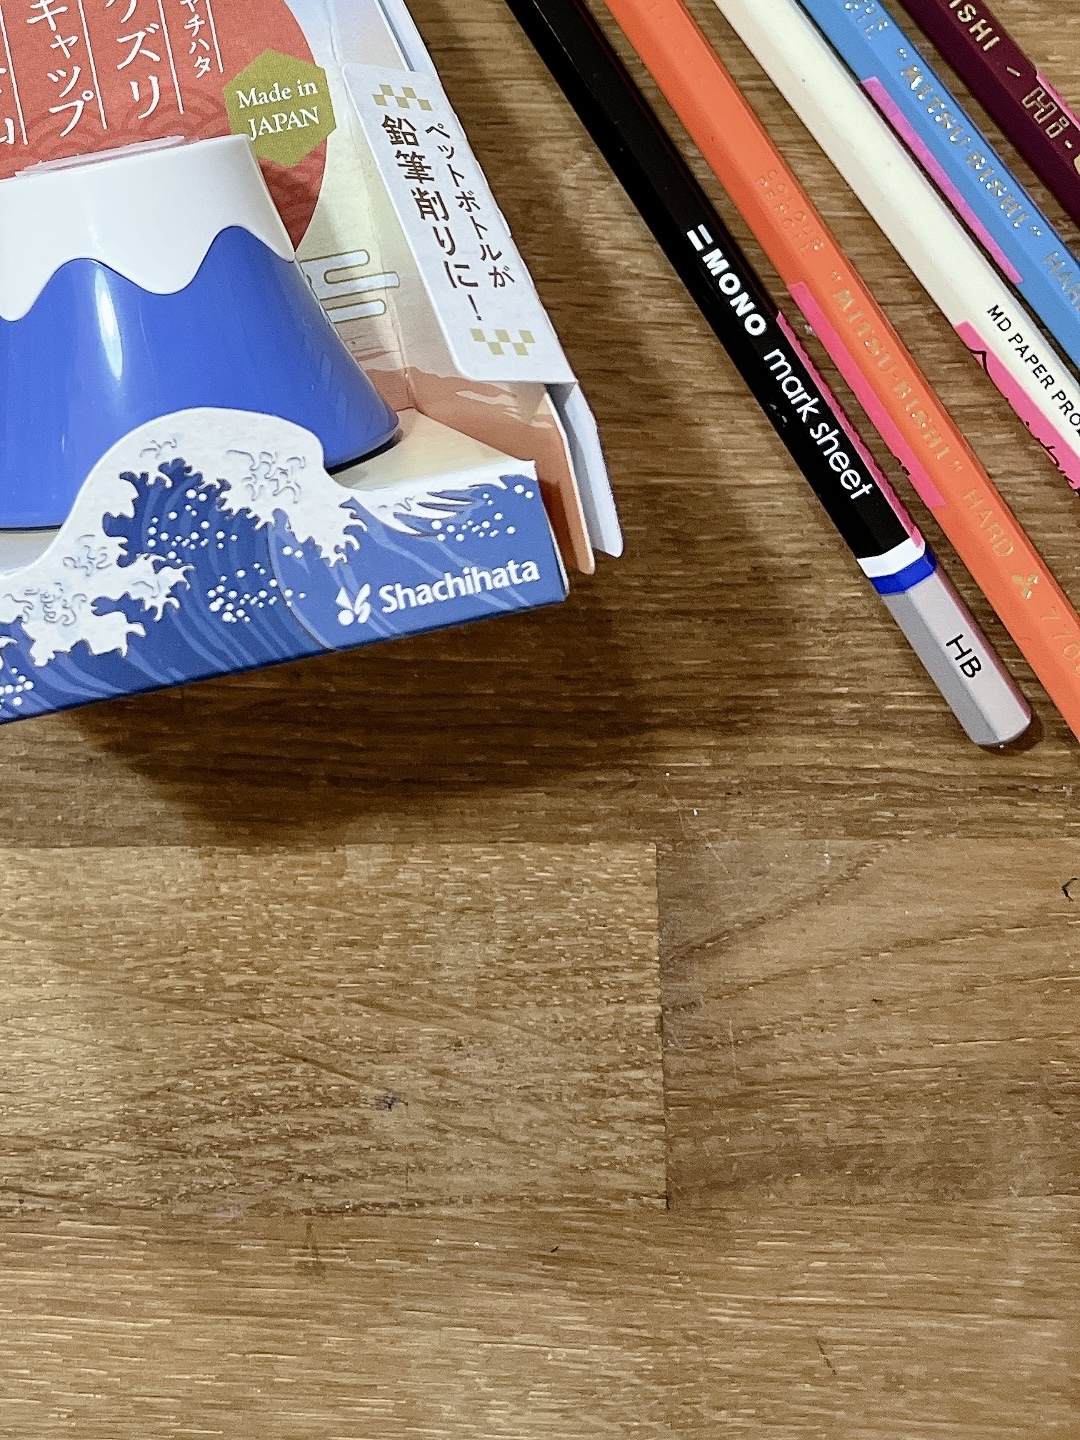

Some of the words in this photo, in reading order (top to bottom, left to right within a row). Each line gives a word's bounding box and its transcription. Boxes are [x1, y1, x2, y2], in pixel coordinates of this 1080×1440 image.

[237, 81, 292, 110] Made
[295, 78, 319, 97] in
[247, 106, 321, 142] JAPAN
[424, 121, 516, 289] ペットボトルが
[1041, 251, 1080, 317] HAR
[701, 247, 768, 337] MONO
[762, 348, 820, 423] mark
[809, 421, 873, 500] sheet
[985, 304, 1012, 333] MD
[1007, 332, 1056, 391] PAPER
[1051, 389, 1080, 437] PRO
[960, 486, 1016, 557] HARD
[378, 559, 541, 614] Shachihata
[945, 633, 983, 679] HB
